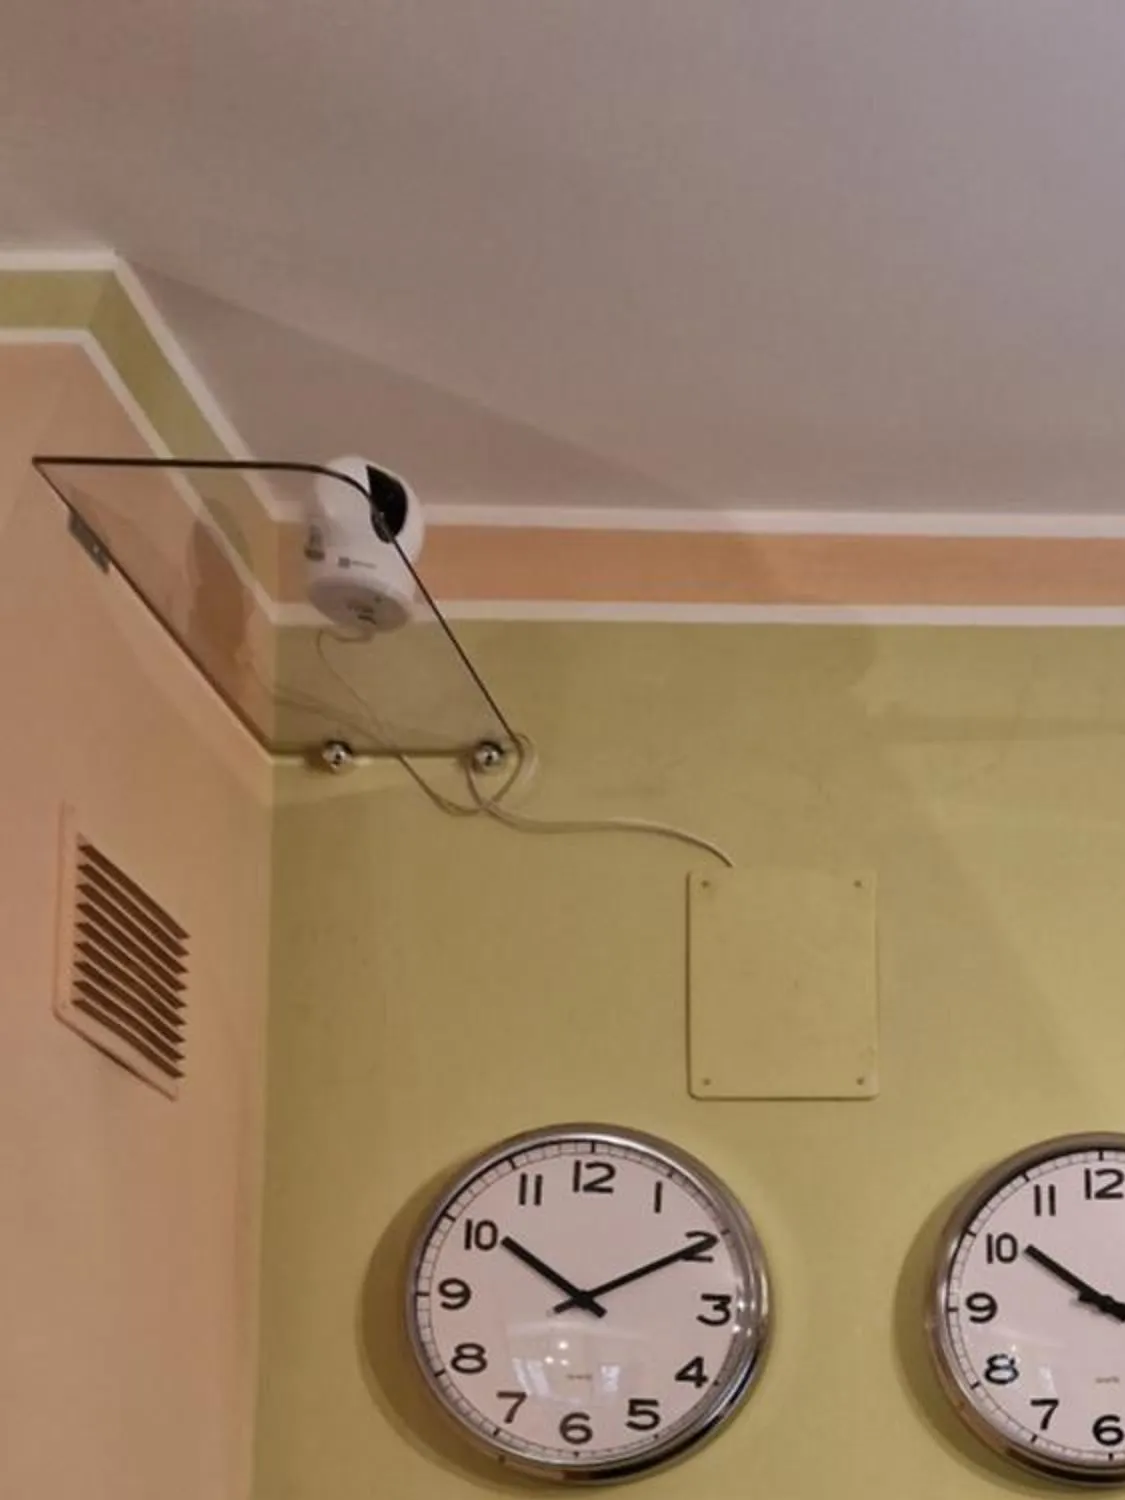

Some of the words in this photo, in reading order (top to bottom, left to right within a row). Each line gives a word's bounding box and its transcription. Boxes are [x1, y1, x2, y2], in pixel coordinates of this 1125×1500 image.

[573, 1160, 616, 1193] 12
[1084, 1168, 1125, 1200] 12
[464, 1219, 499, 1251] 10
[986, 1232, 1018, 1264] 10
[438, 1278, 472, 1310] 9
[696, 1293, 733, 1326] 3
[965, 1292, 998, 1323] 9
[450, 1343, 487, 1374] 8
[674, 1356, 708, 1388] 4
[984, 1353, 1019, 1385] 8
[497, 1391, 527, 1424] 7
[625, 1399, 660, 1431] 5
[1030, 1398, 1060, 1431] 7
[559, 1412, 593, 1445] 6
[1092, 1414, 1125, 1447] 6
